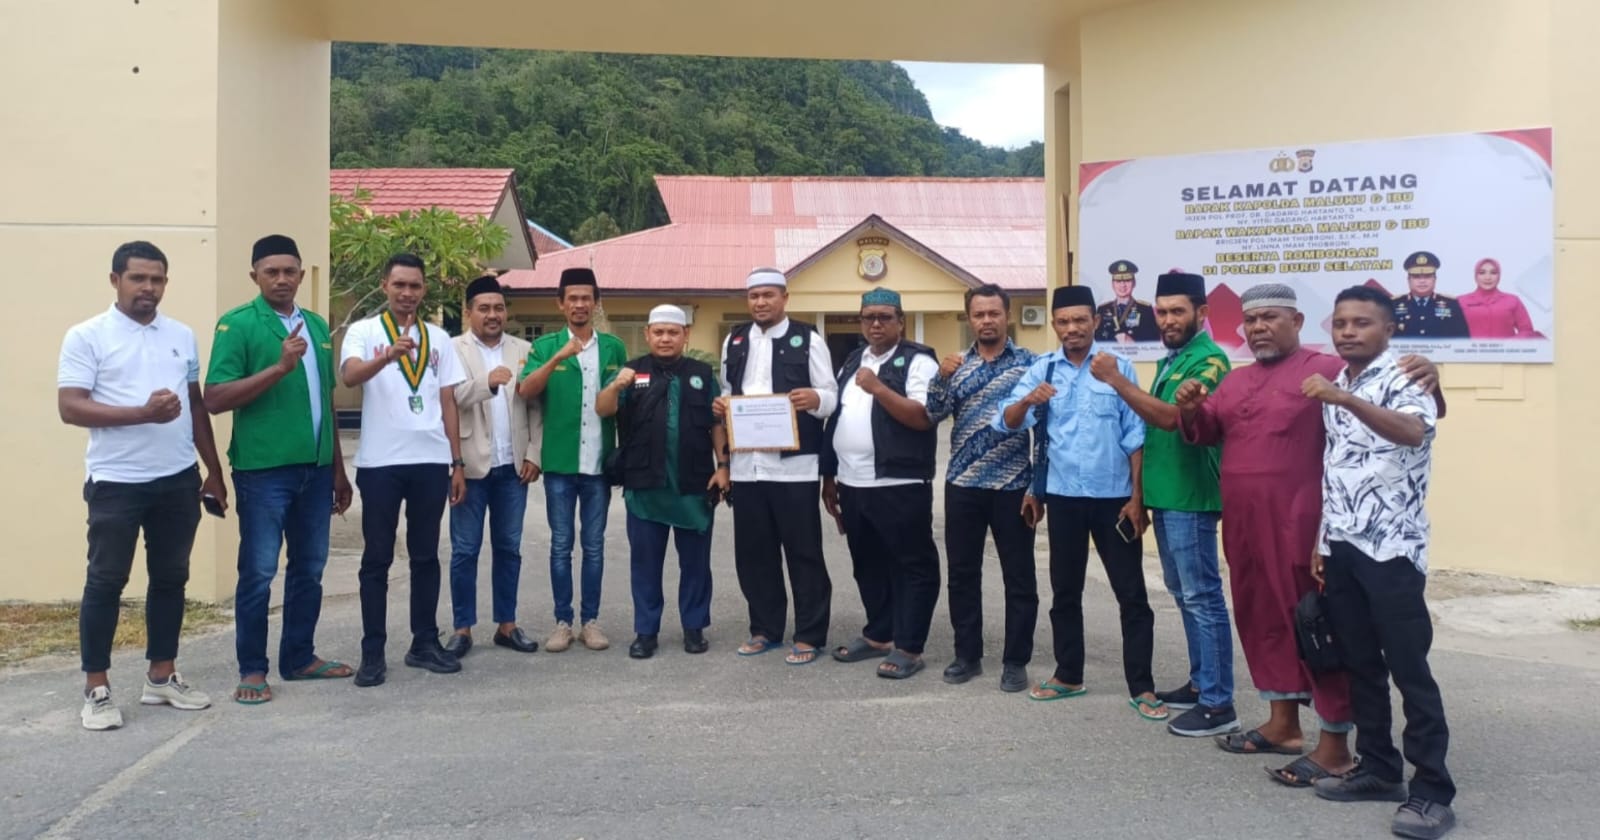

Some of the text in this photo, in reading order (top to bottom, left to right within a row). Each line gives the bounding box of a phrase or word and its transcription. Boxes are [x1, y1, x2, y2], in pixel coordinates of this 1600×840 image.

[1181, 174, 1418, 201] SELAMAT DATANG
[1184, 192, 1414, 215] BAPAK KAPOLDA MALUKU & IBU
[1264, 209, 1299, 217] DADANG
[1274, 215, 1308, 223] DADANG
[1175, 218, 1430, 240] BAPAK WAKAPOLDA MALUKU & IBU
[1216, 247, 1379, 263] BESERTA ROMBONGAN
[1202, 259, 1393, 275] DI POLRES BURU SELATAN
